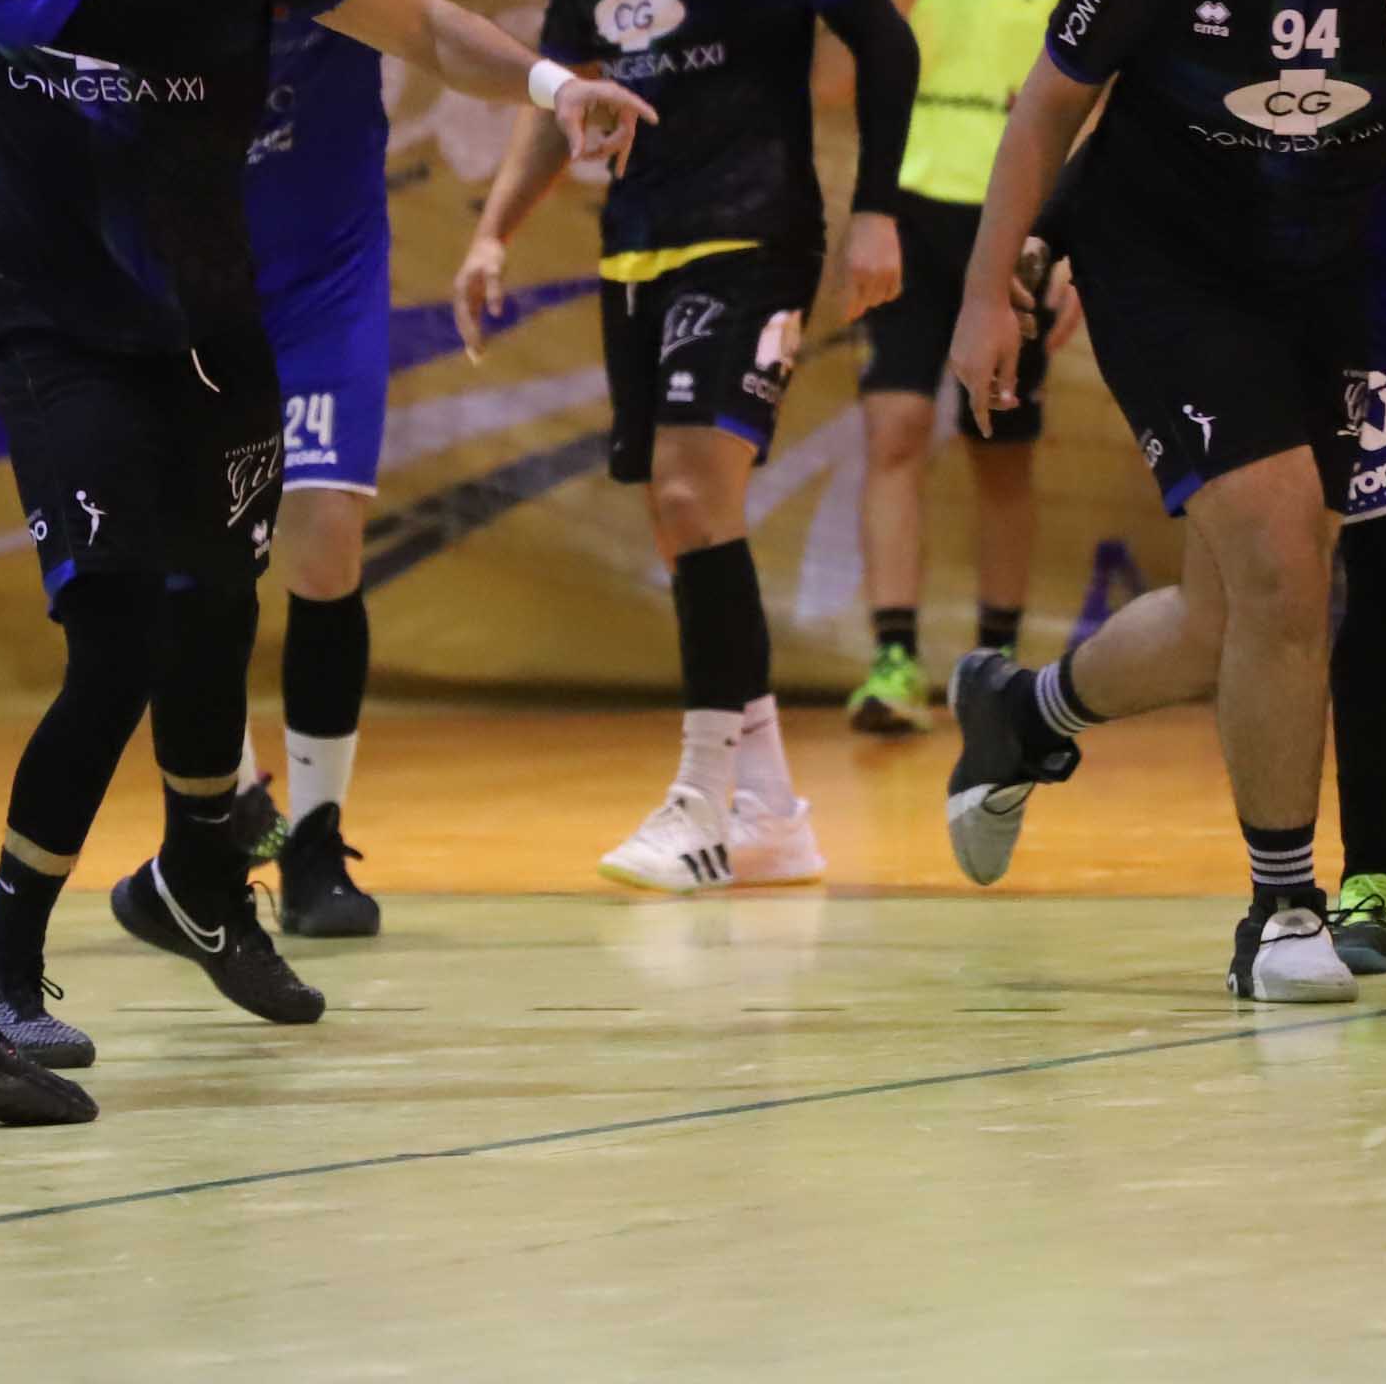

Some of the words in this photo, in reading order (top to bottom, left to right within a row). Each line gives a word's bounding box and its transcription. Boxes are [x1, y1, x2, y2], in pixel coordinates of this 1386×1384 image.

[615, 0, 654, 32] CG
[1269, 7, 1342, 61] 94
[165, 77, 205, 102] XXI
[1264, 90, 1333, 117] CG
[284, 392, 334, 450] 24
